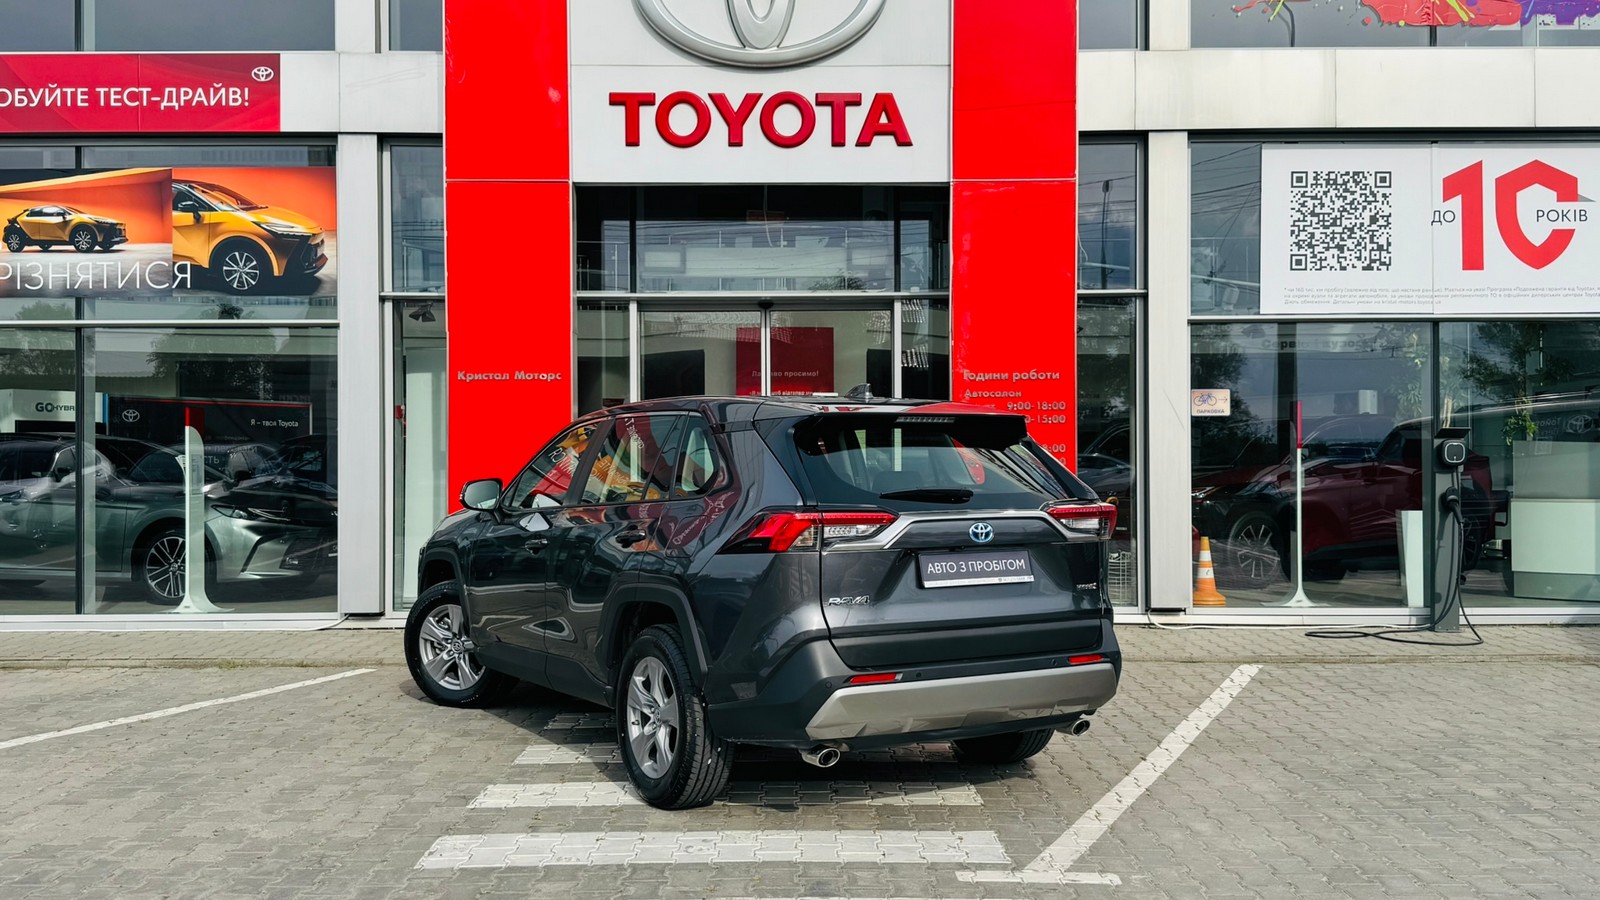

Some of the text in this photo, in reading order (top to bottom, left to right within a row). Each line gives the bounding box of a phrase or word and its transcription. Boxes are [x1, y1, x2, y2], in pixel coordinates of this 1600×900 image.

[95, 82, 250, 110] ТЕСТ-ДРАЙВ!
[609, 91, 913, 149] TOYOTA
[1431, 209, 1456, 226] ДО
[1535, 208, 1588, 224] РОКІВ
[457, 371, 562, 383] Кристал Моторс
[784, 370, 819, 378] просимо!
[963, 369, 1060, 382] Години роботи
[964, 389, 1022, 398] Автосалон
[250, 419, 256, 427] Я
[278, 419, 299, 429] Toyota
[927, 560, 957, 574] АВТО
[969, 557, 1026, 571] ПРОБІГОМ
[828, 595, 870, 606] RAV4
